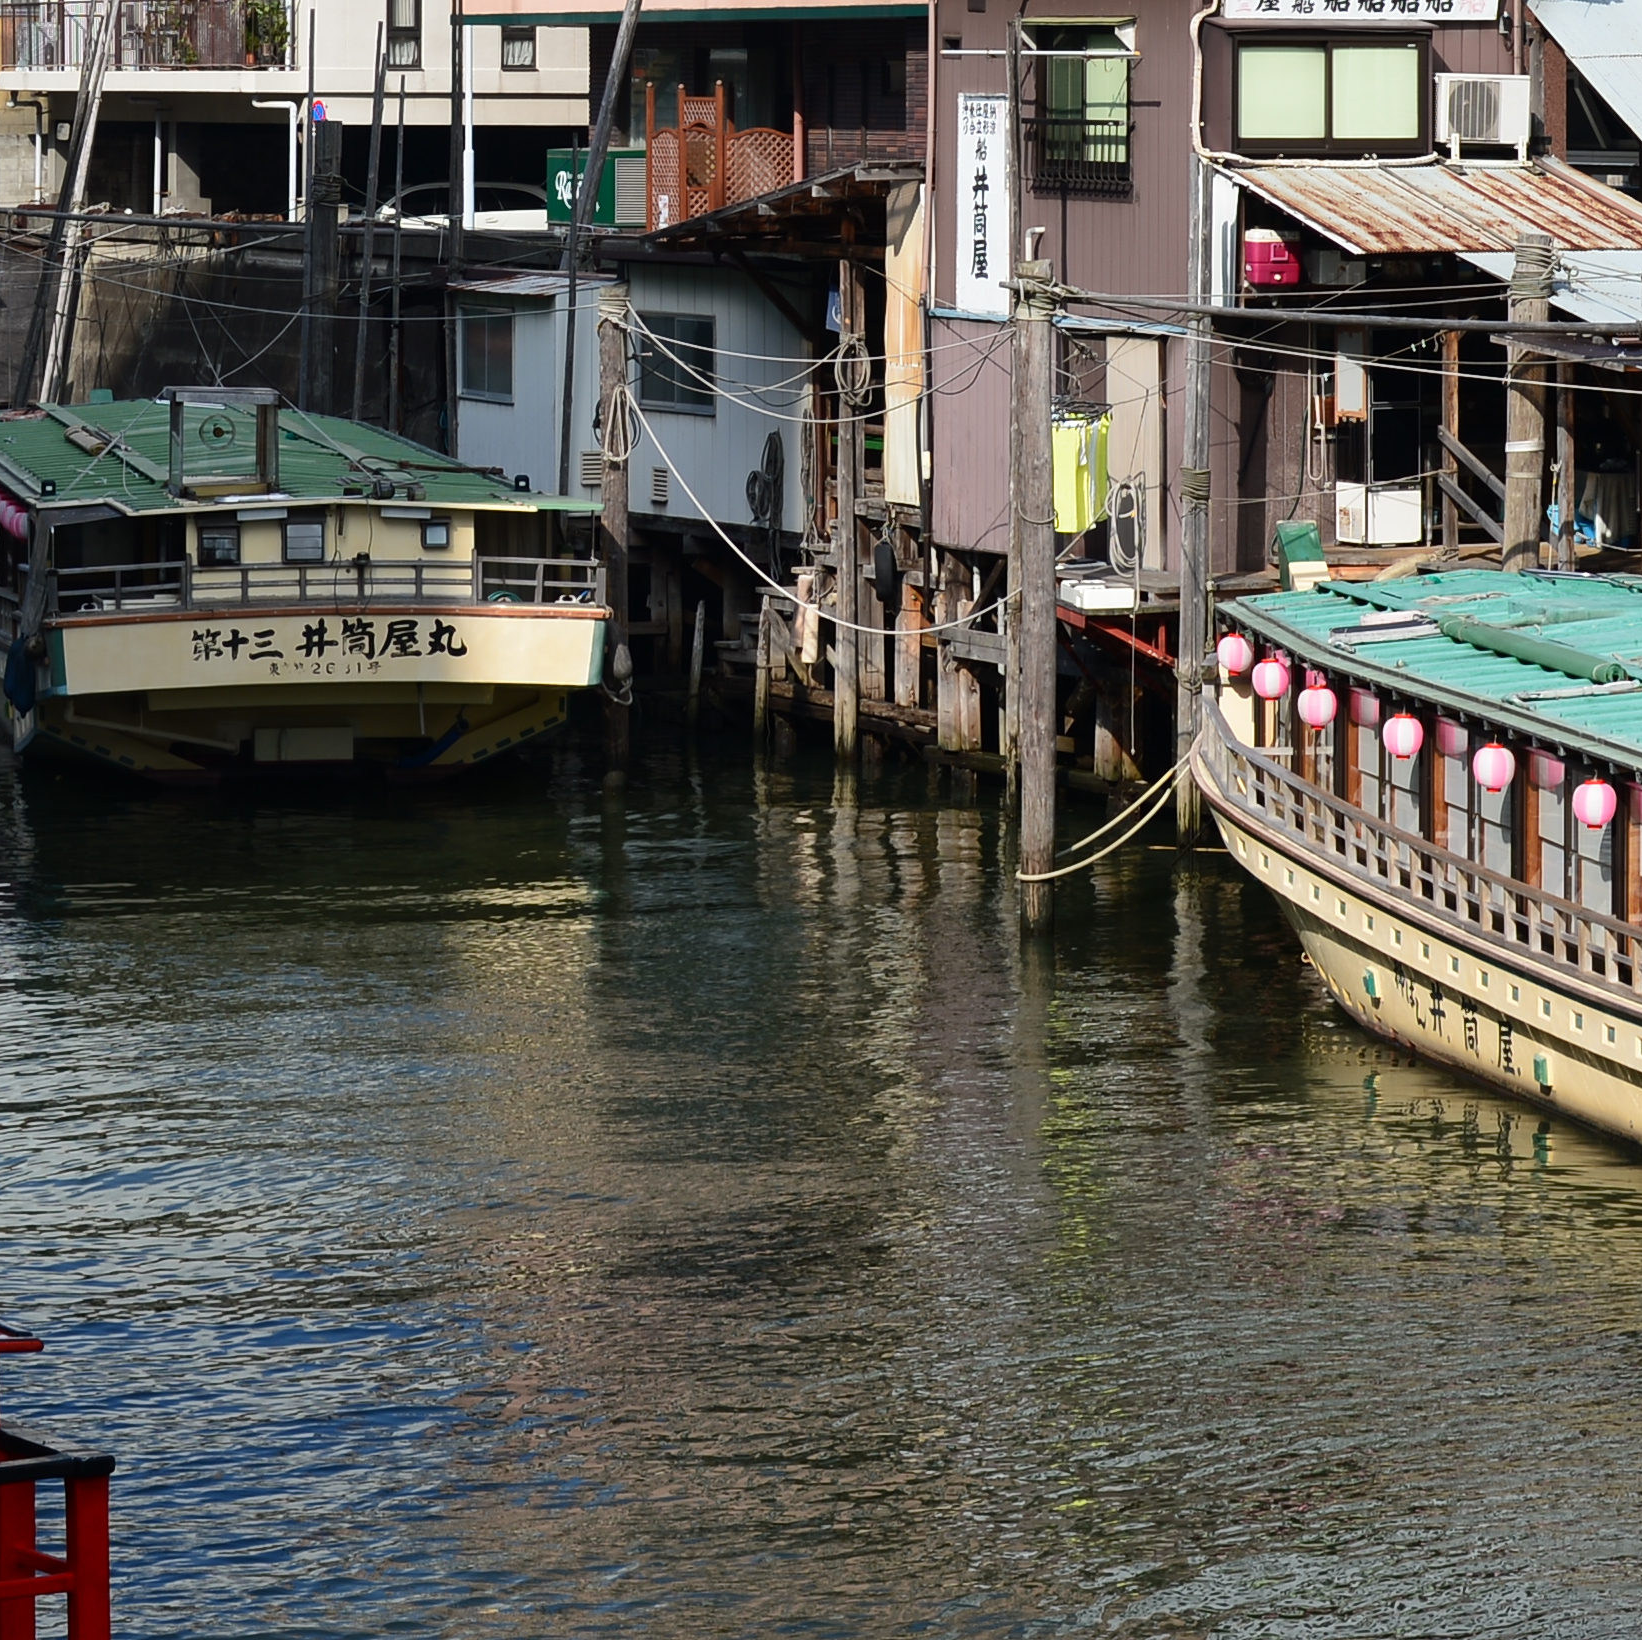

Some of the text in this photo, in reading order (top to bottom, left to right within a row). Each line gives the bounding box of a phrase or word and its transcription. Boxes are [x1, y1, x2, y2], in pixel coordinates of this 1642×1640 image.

[970, 165, 990, 280] 井筒屋
[191, 618, 468, 661] 第十三 井筒屋丸
[1429, 981, 1516, 1076] 井筒屋
